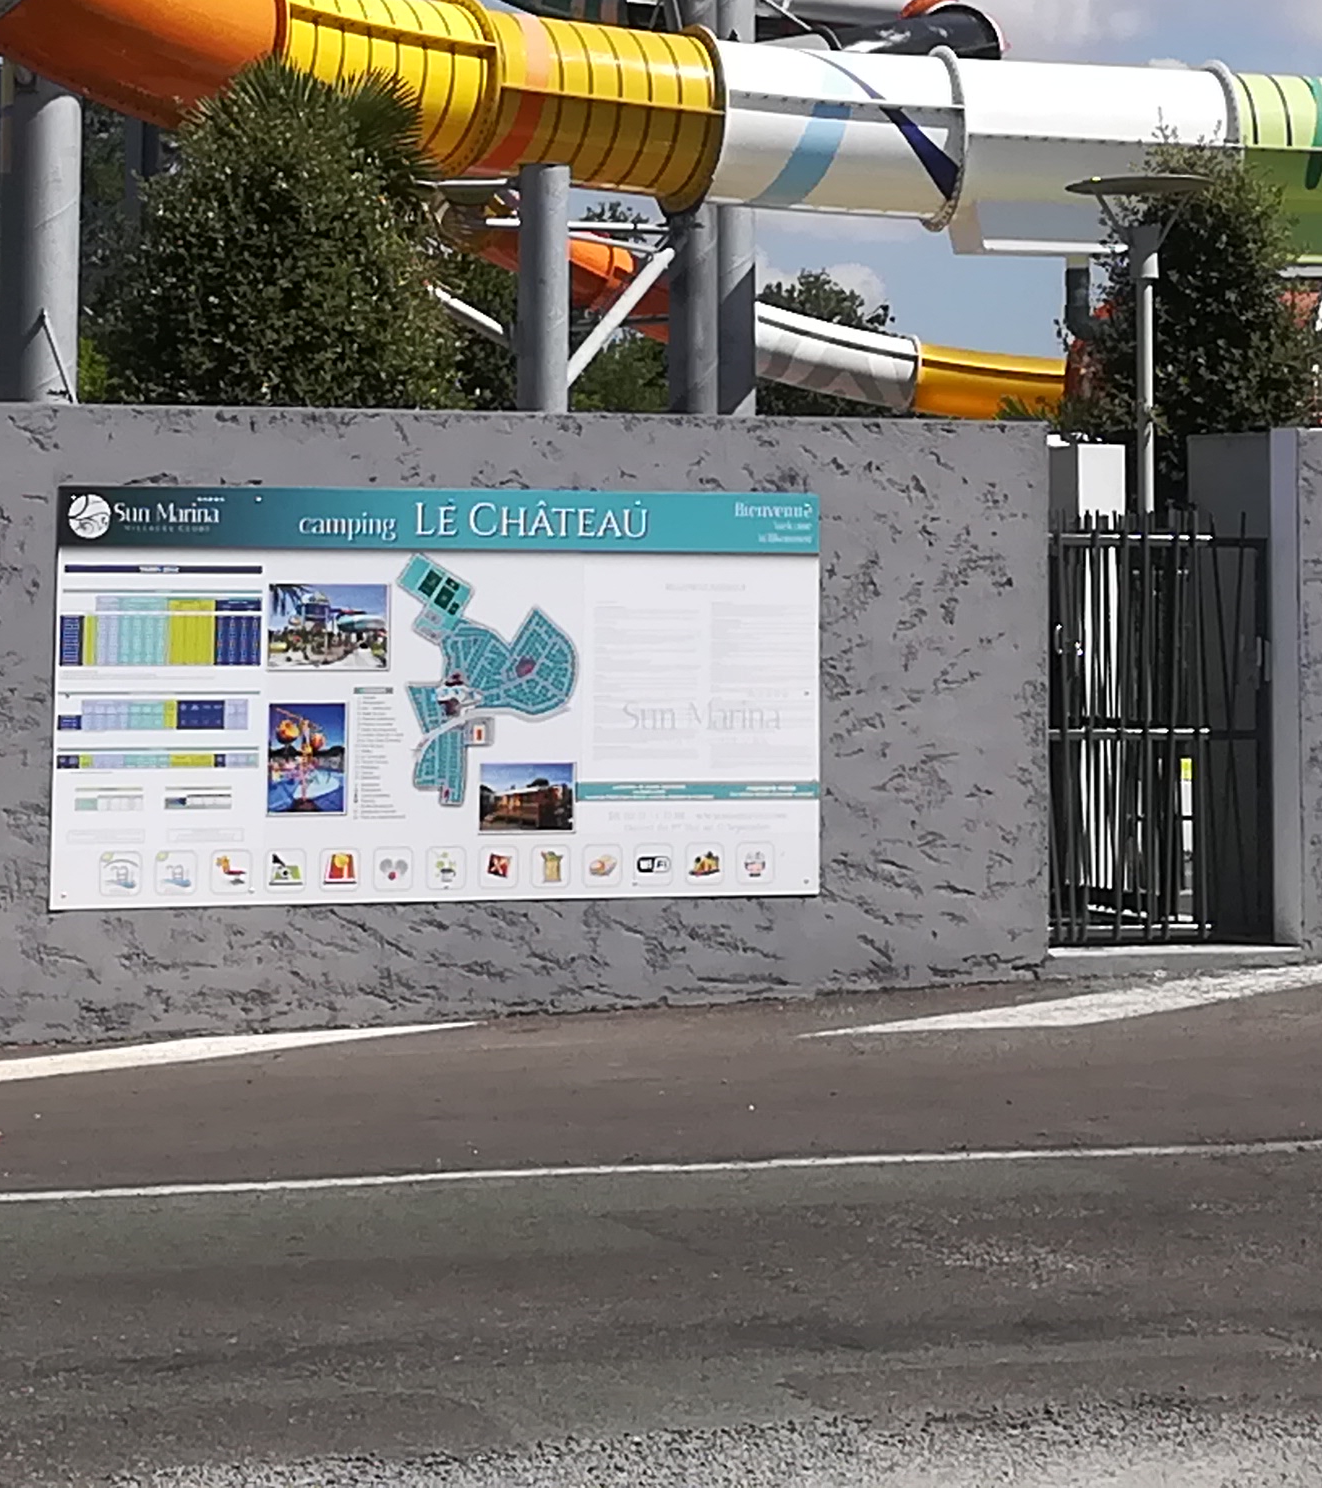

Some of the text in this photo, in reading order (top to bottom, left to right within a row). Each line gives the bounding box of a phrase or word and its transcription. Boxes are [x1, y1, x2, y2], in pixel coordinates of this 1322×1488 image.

[113, 502, 220, 523] Sun Marina
[299, 512, 397, 541] camping
[469, 500, 649, 538] CHÂTEAU
[734, 501, 813, 518] Bienvenue
[622, 700, 782, 731] Sun Marina
